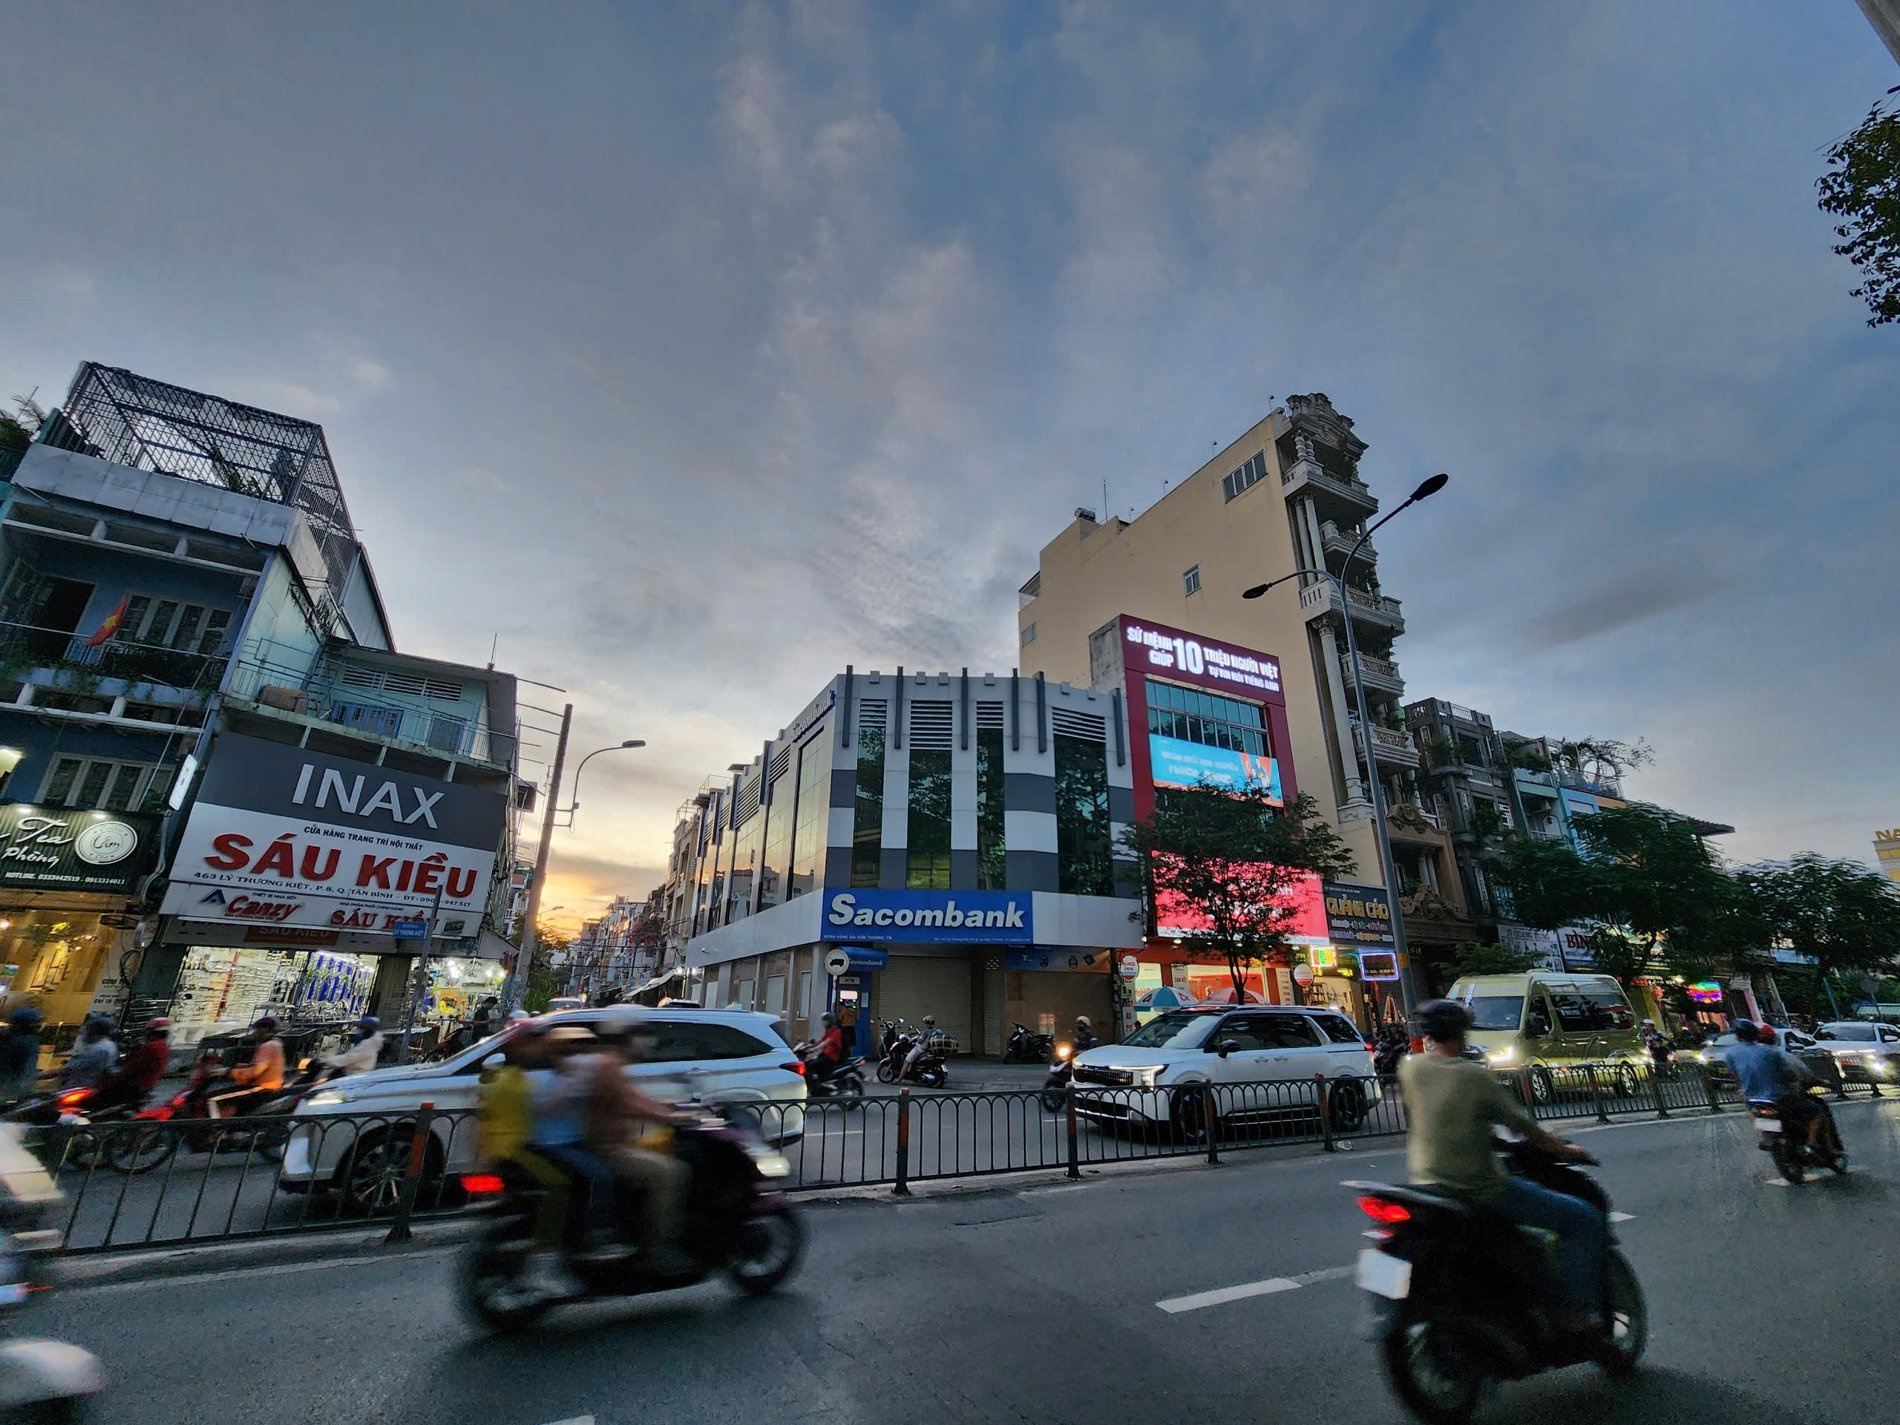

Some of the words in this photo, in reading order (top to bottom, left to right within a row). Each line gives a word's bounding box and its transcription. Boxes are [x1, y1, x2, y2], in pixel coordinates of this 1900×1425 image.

[1143, 631, 1173, 651] MỆNH
[1149, 650, 1174, 667] GIÚP
[1172, 638, 1204, 675] 10
[1202, 647, 1230, 667] TRIỆU
[1230, 654, 1259, 674] NGƯỜI
[1259, 662, 1278, 680] VIỆT
[292, 763, 445, 829] INAX
[322, 829, 345, 839] HÀNG
[347, 833, 374, 844] TRANG
[376, 837, 389, 846] TRÍ
[389, 839, 403, 849] NỘI
[405, 841, 424, 851] THẤT
[204, 832, 342, 882] SÁU
[355, 852, 478, 898] KIỀU
[193, 872, 217, 880] 463
[370, 891, 393, 899] BÌNH
[227, 895, 303, 921] Canzy
[330, 907, 378, 928] SÁU
[828, 893, 1025, 928] Sacombank
[1326, 893, 1365, 918] QUẢNG
[1365, 897, 1390, 920] CÁO
